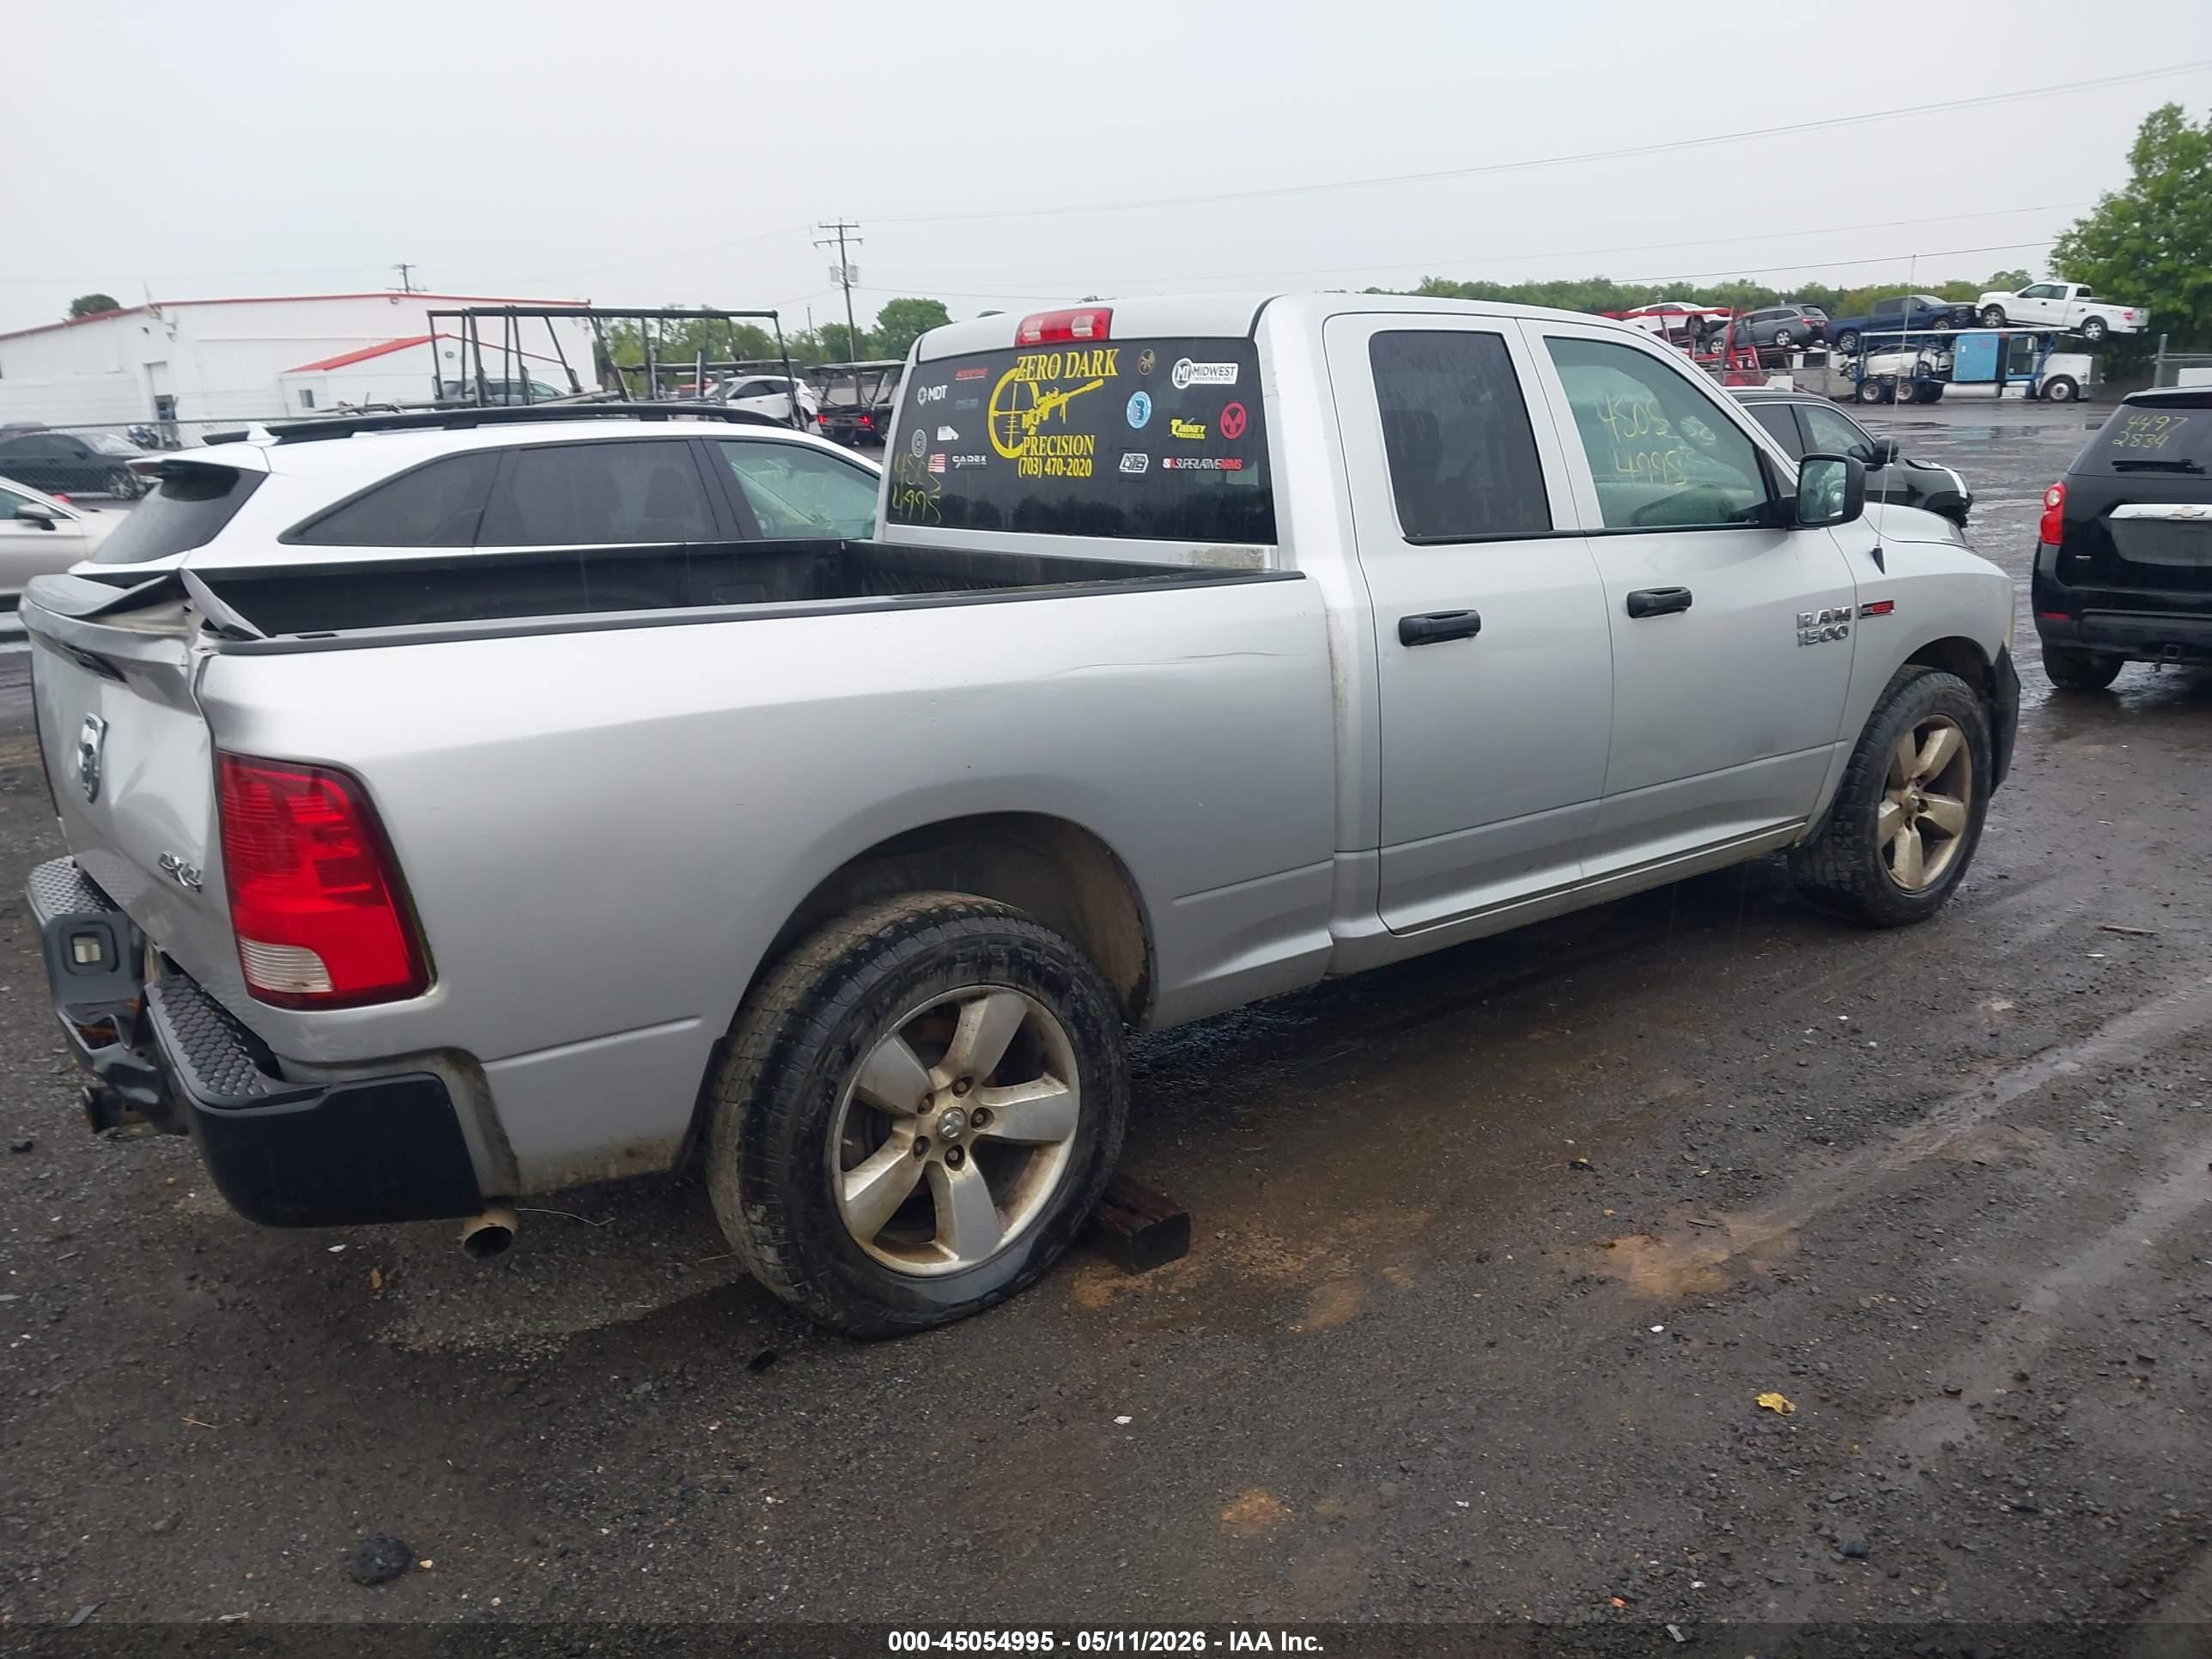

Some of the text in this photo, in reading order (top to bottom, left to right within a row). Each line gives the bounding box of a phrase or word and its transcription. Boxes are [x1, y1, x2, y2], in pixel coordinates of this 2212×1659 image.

[1013, 349, 1120, 381] ZERO DARK
[1191, 366, 1236, 376] MIDWEST
[2125, 414, 2189, 432] 4497
[1022, 434, 1096, 457] PRECISION
[2112, 430, 2170, 449] 2834
[952, 455, 987, 465] CADEX
[1018, 457, 1093, 479] (703) 470-2020
[1613, 450, 1687, 487] 4995
[1797, 606, 1852, 629] RAM
[1797, 624, 1849, 647] 1500
